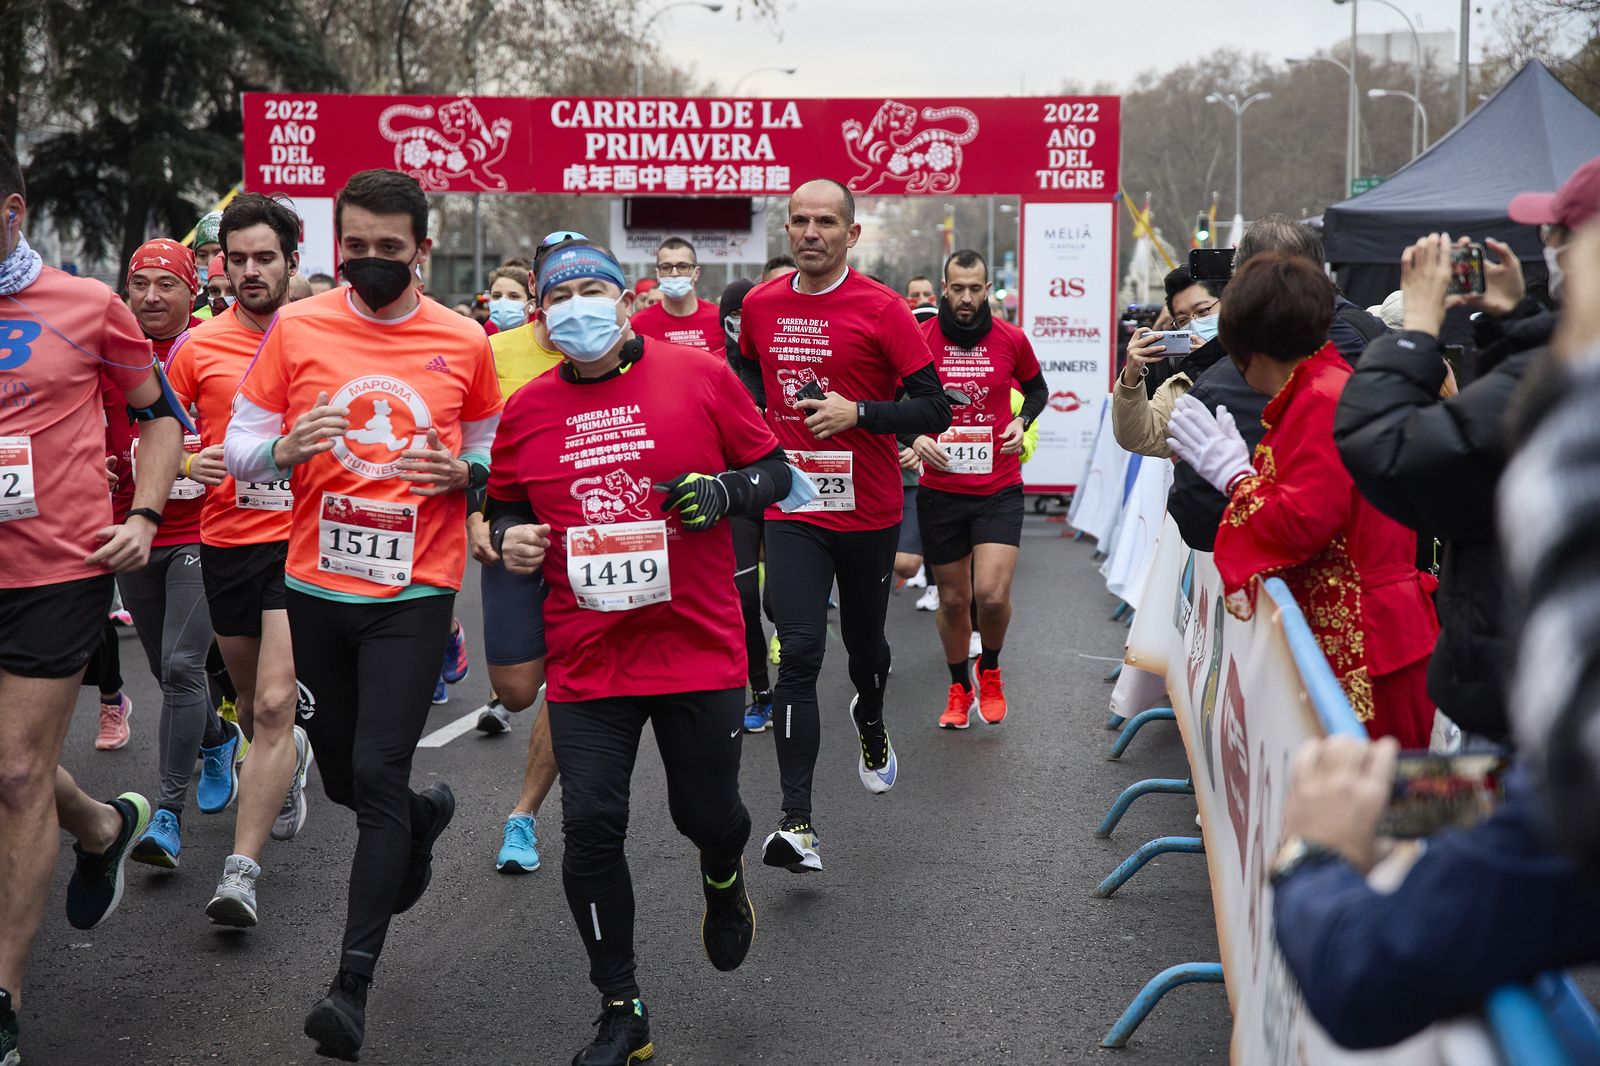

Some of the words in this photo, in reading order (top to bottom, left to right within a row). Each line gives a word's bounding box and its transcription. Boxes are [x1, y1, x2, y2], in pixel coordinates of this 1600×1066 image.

[264, 100, 318, 120] 2022
[550, 101, 703, 129] CARRERA
[710, 101, 753, 129] DE
[761, 101, 803, 129] LA
[1044, 103, 1099, 123] 2022
[268, 121, 316, 145] AÑO
[1047, 124, 1096, 148] AÑO
[271, 146, 314, 165] DEL
[585, 133, 776, 160] PRIMAVERA
[1048, 150, 1092, 168] DEL
[259, 166, 326, 186] TIGRE
[563, 164, 791, 191] 虎年西中春节公路跑
[1036, 170, 1104, 190] TIGRE
[1049, 276, 1086, 298] as
[777, 318, 808, 326] CARRERA
[783, 326, 822, 334] PRIMAVERA
[425, 364, 450, 374] adidas
[348, 380, 412, 402] MAPOMA
[566, 409, 610, 426] CARRERA
[612, 406, 626, 416] DE
[627, 404, 640, 414] LA
[576, 415, 633, 432] PRIMAVERA
[565, 438, 584, 449] 2022
[586, 434, 602, 444] AÑO
[604, 430, 620, 440] DEL
[621, 428, 646, 438] TIGRE
[945, 446, 988, 460] 1416
[344, 454, 403, 476] RUNNER
[810, 478, 846, 494] 23
[329, 528, 402, 560] 1511
[580, 558, 658, 586] 1419
